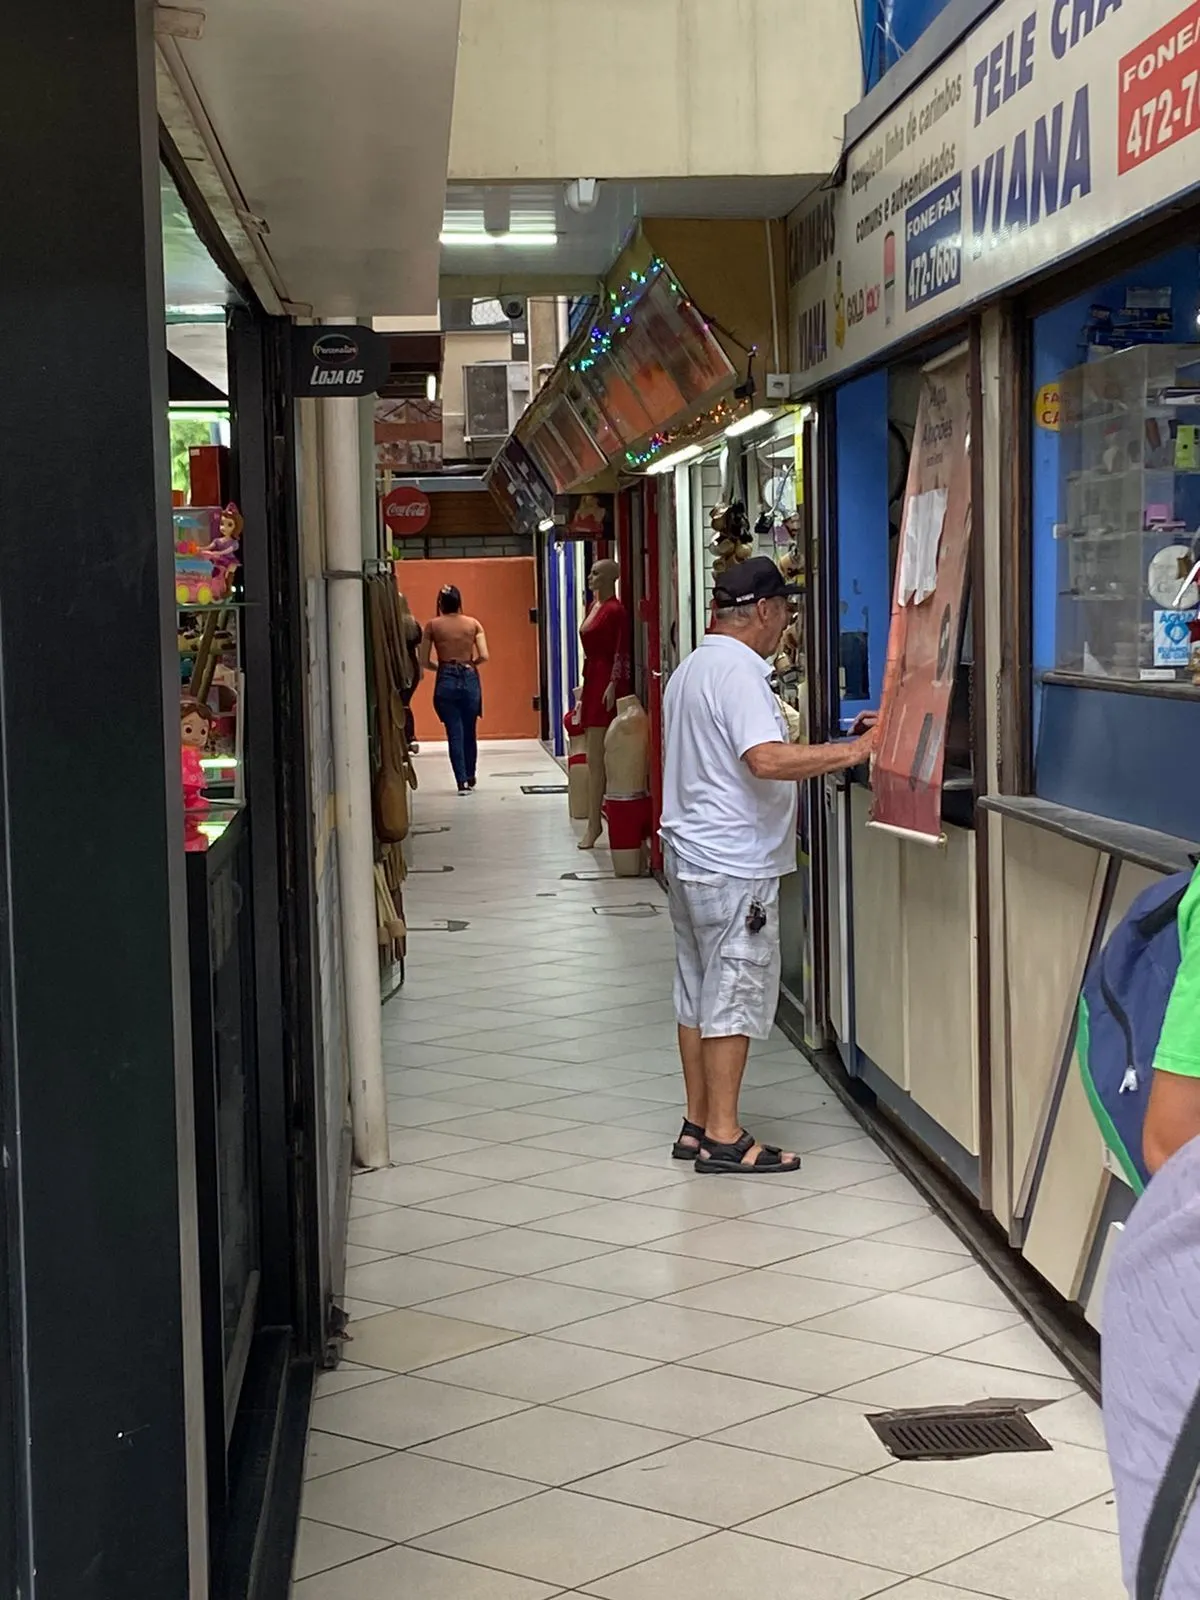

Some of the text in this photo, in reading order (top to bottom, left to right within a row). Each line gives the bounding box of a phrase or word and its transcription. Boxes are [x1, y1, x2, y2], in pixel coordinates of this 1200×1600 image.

[973, 0, 1122, 129] TELE CH
[851, 73, 962, 196] completa linha de carimbos
[1126, 69, 1200, 159] 472-7
[971, 83, 1092, 260] VIANA
[789, 190, 836, 290] CARIMBOS
[856, 203, 883, 244] comuns
[884, 197, 890, 222] e
[310, 365, 365, 385] LOJA 05
[798, 298, 828, 373] VIANA
